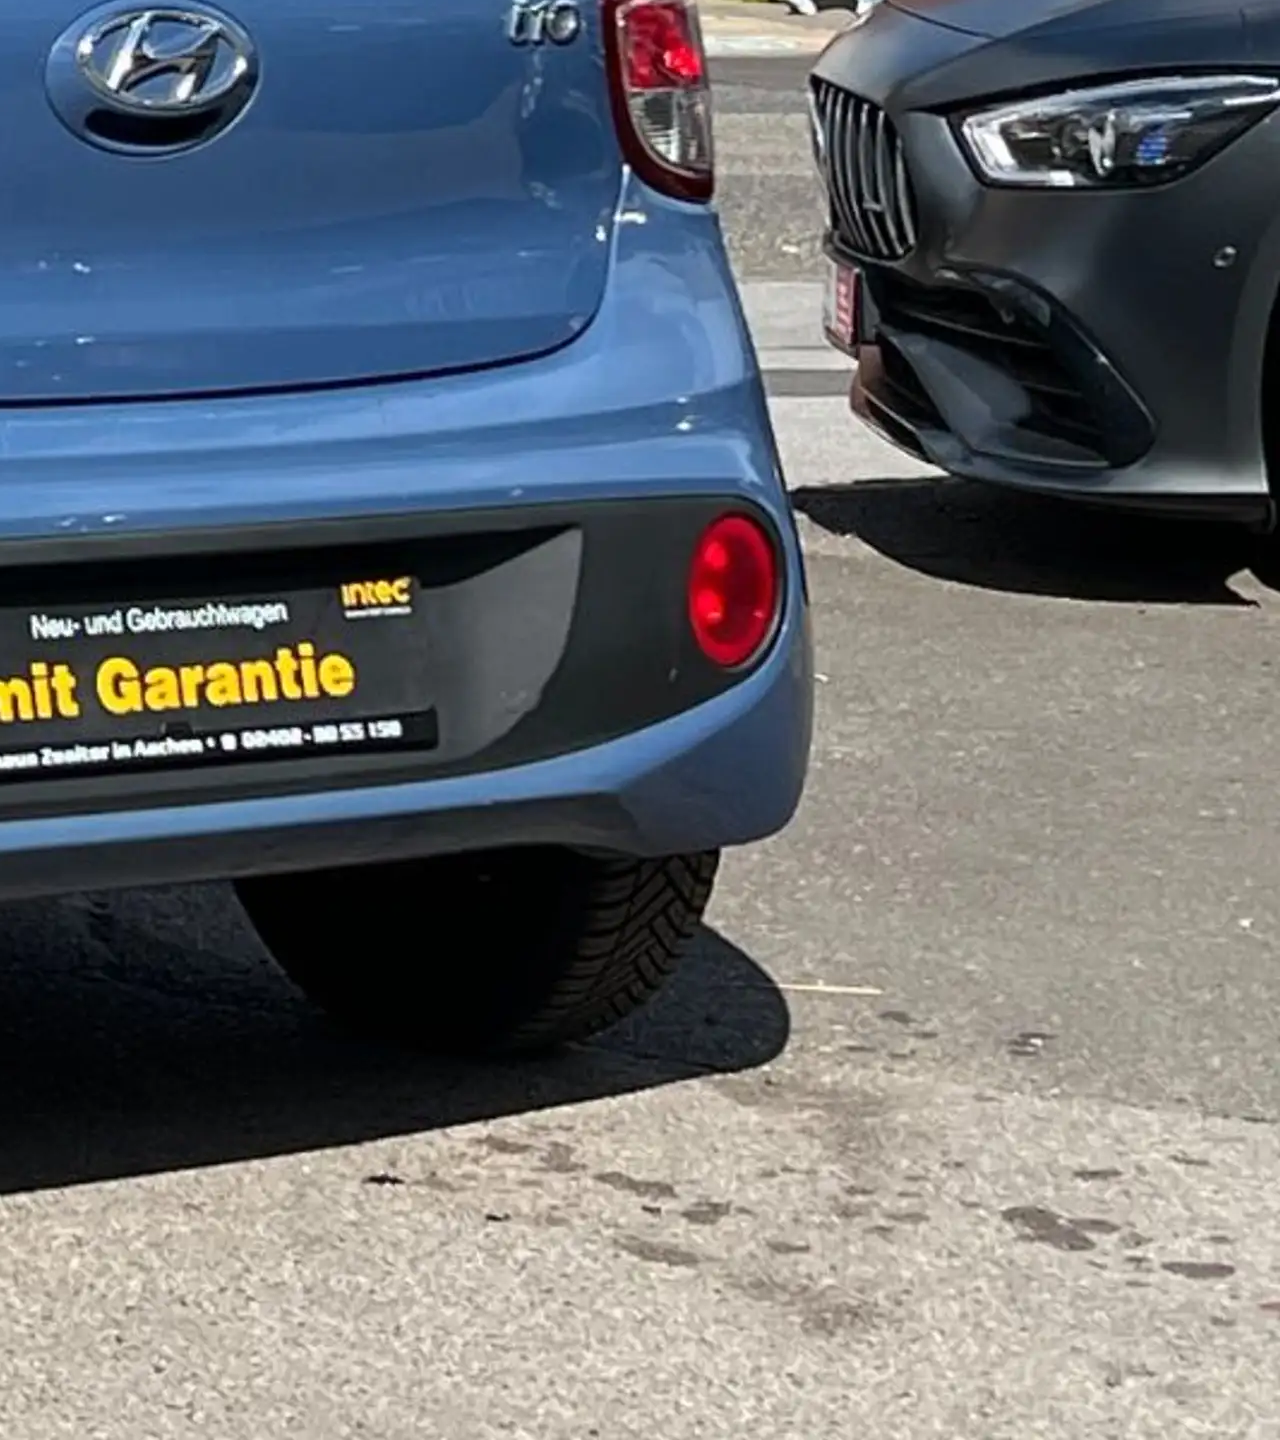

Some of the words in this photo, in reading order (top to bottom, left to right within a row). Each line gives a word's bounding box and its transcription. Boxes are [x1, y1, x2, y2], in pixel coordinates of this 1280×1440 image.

[30, 613, 80, 640] Neu-
[84, 610, 123, 634] und
[126, 602, 289, 632] Gebrauchtwagen
[96, 641, 356, 715] Garantie
[134, 737, 204, 756] Aachen
